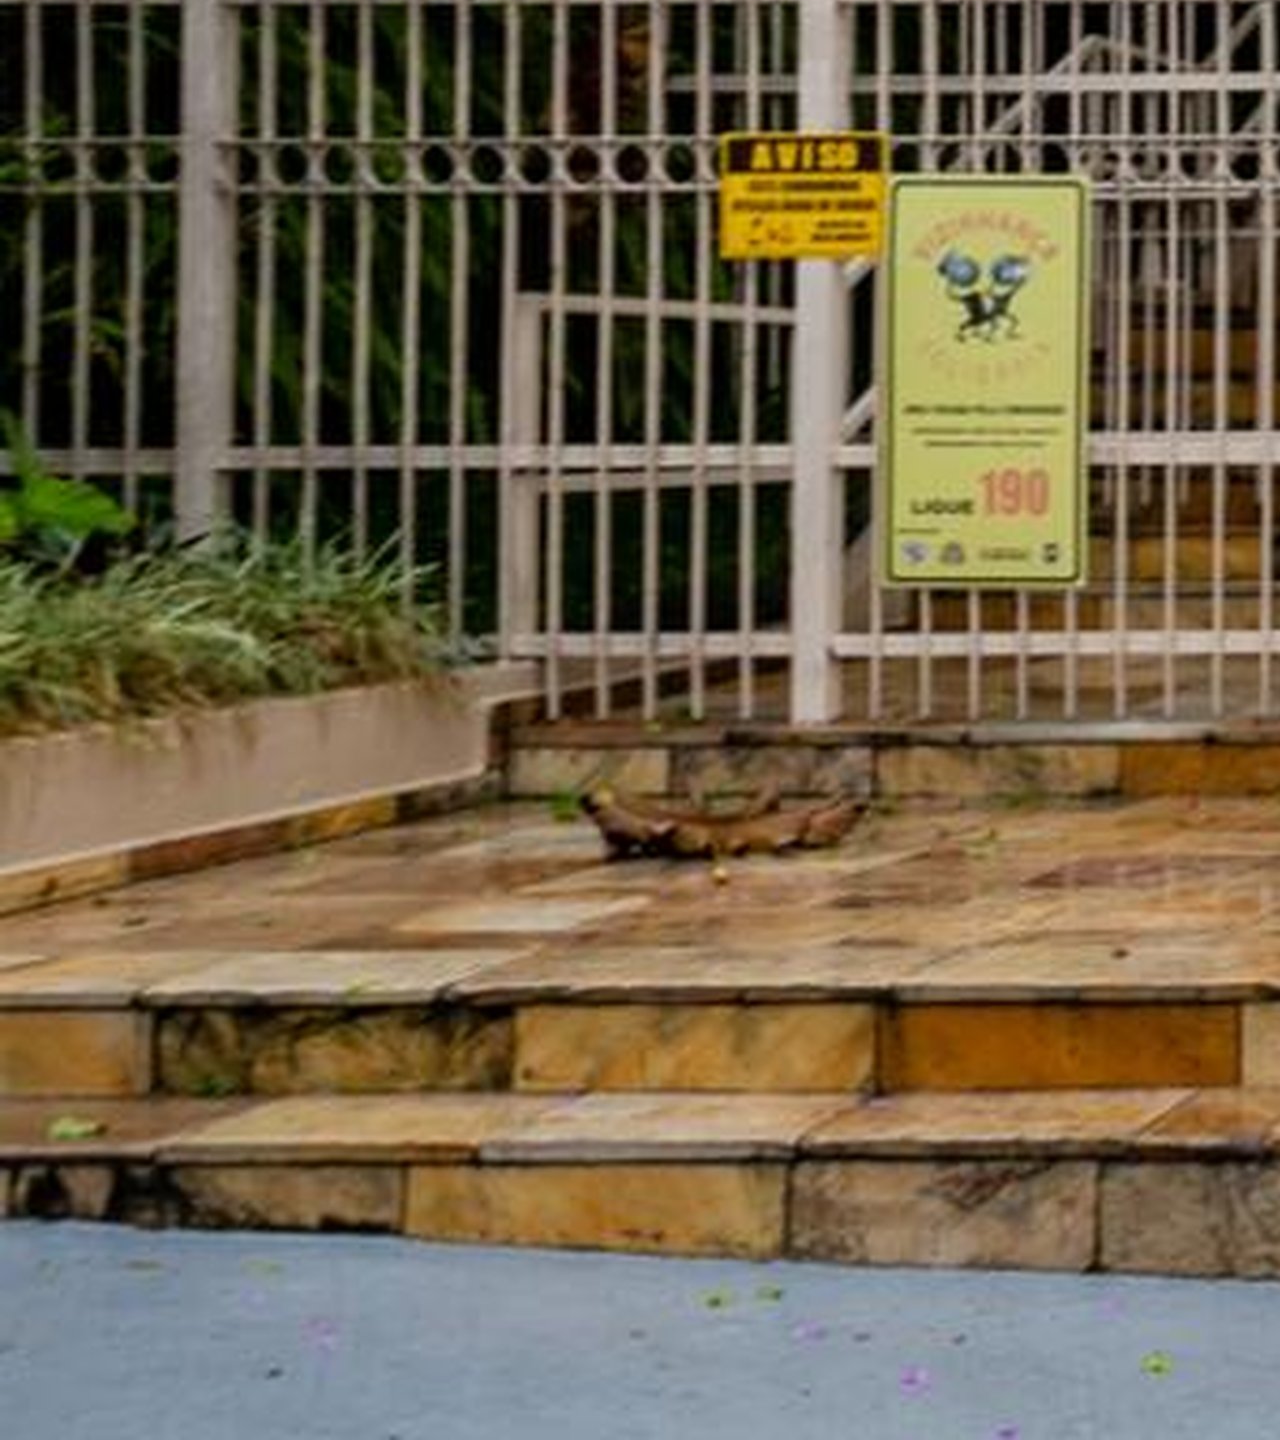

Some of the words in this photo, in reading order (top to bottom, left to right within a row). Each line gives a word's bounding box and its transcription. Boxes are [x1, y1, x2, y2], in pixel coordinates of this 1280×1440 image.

[750, 140, 860, 171] AVISO
[909, 497, 975, 517] LIGUE
[976, 466, 1050, 517] 190
